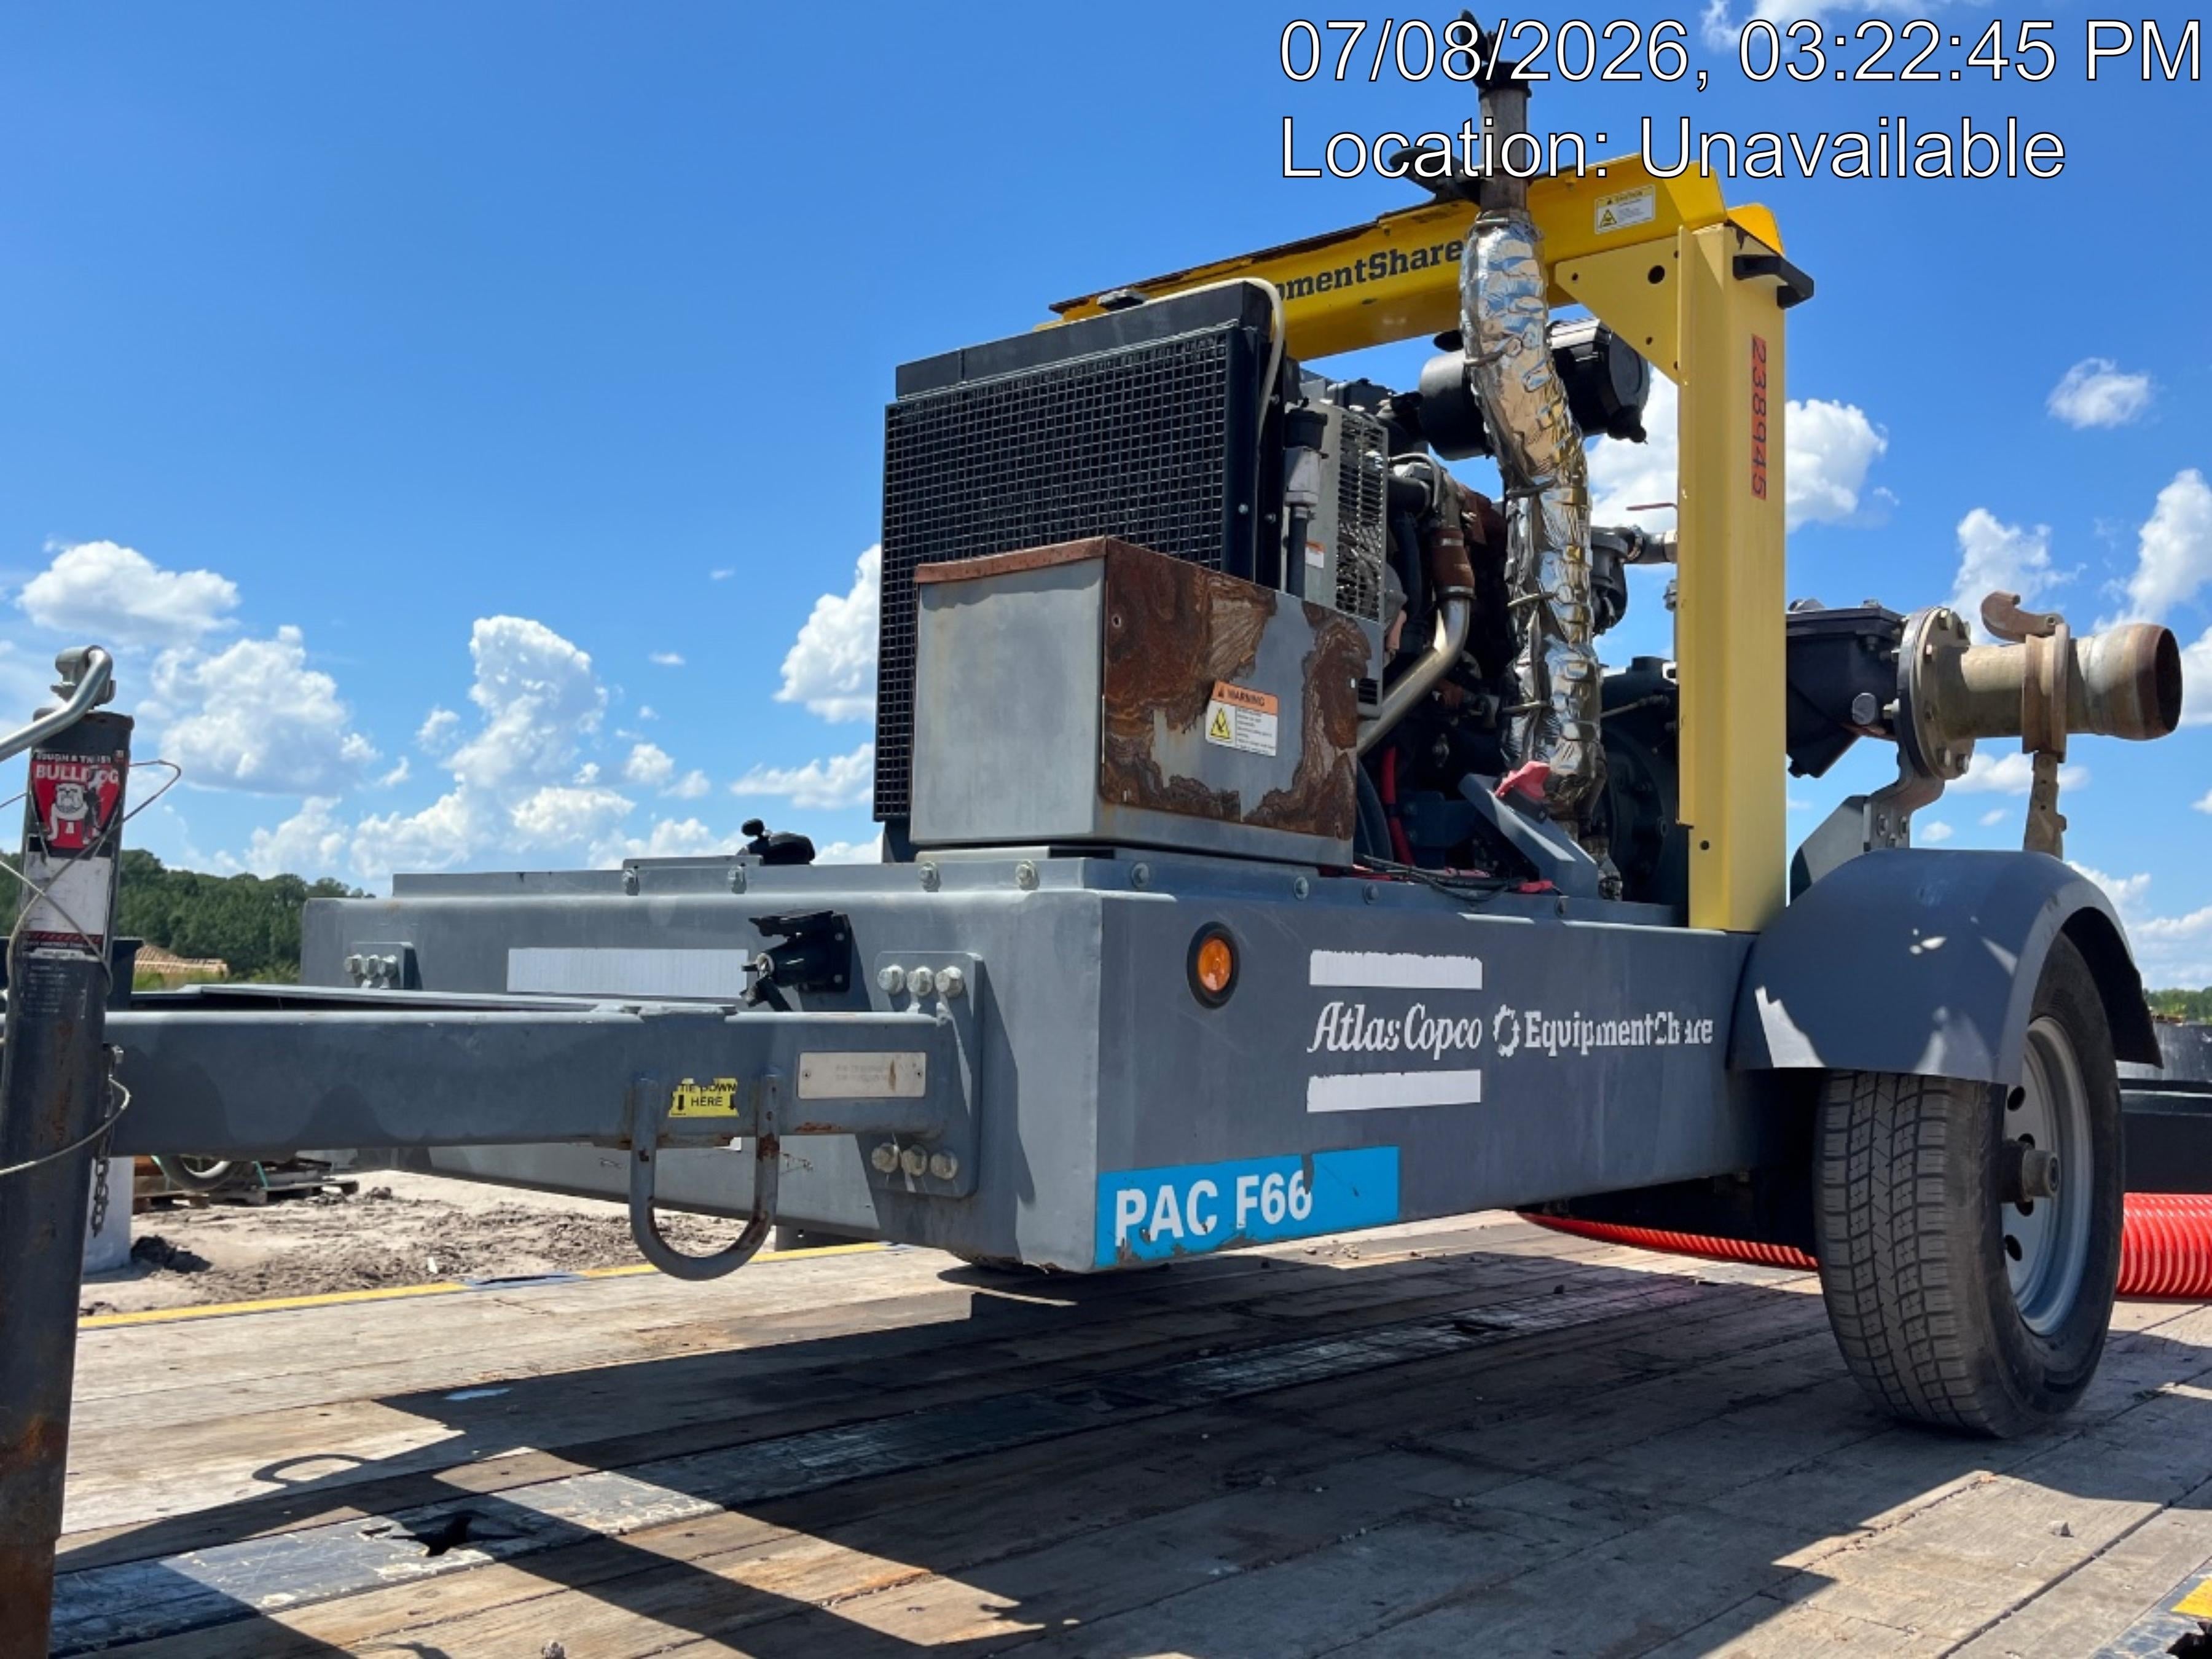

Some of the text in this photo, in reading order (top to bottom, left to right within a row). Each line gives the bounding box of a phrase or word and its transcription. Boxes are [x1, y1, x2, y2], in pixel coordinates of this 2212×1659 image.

[1752, 336, 1767, 500] 238945
[1228, 689, 1265, 707] WARNING
[1306, 1001, 1401, 1053] Atlas
[1404, 1002, 1483, 1061] Copco
[691, 1096, 724, 1107] HERE
[1115, 1169, 1312, 1247] PAC F66
